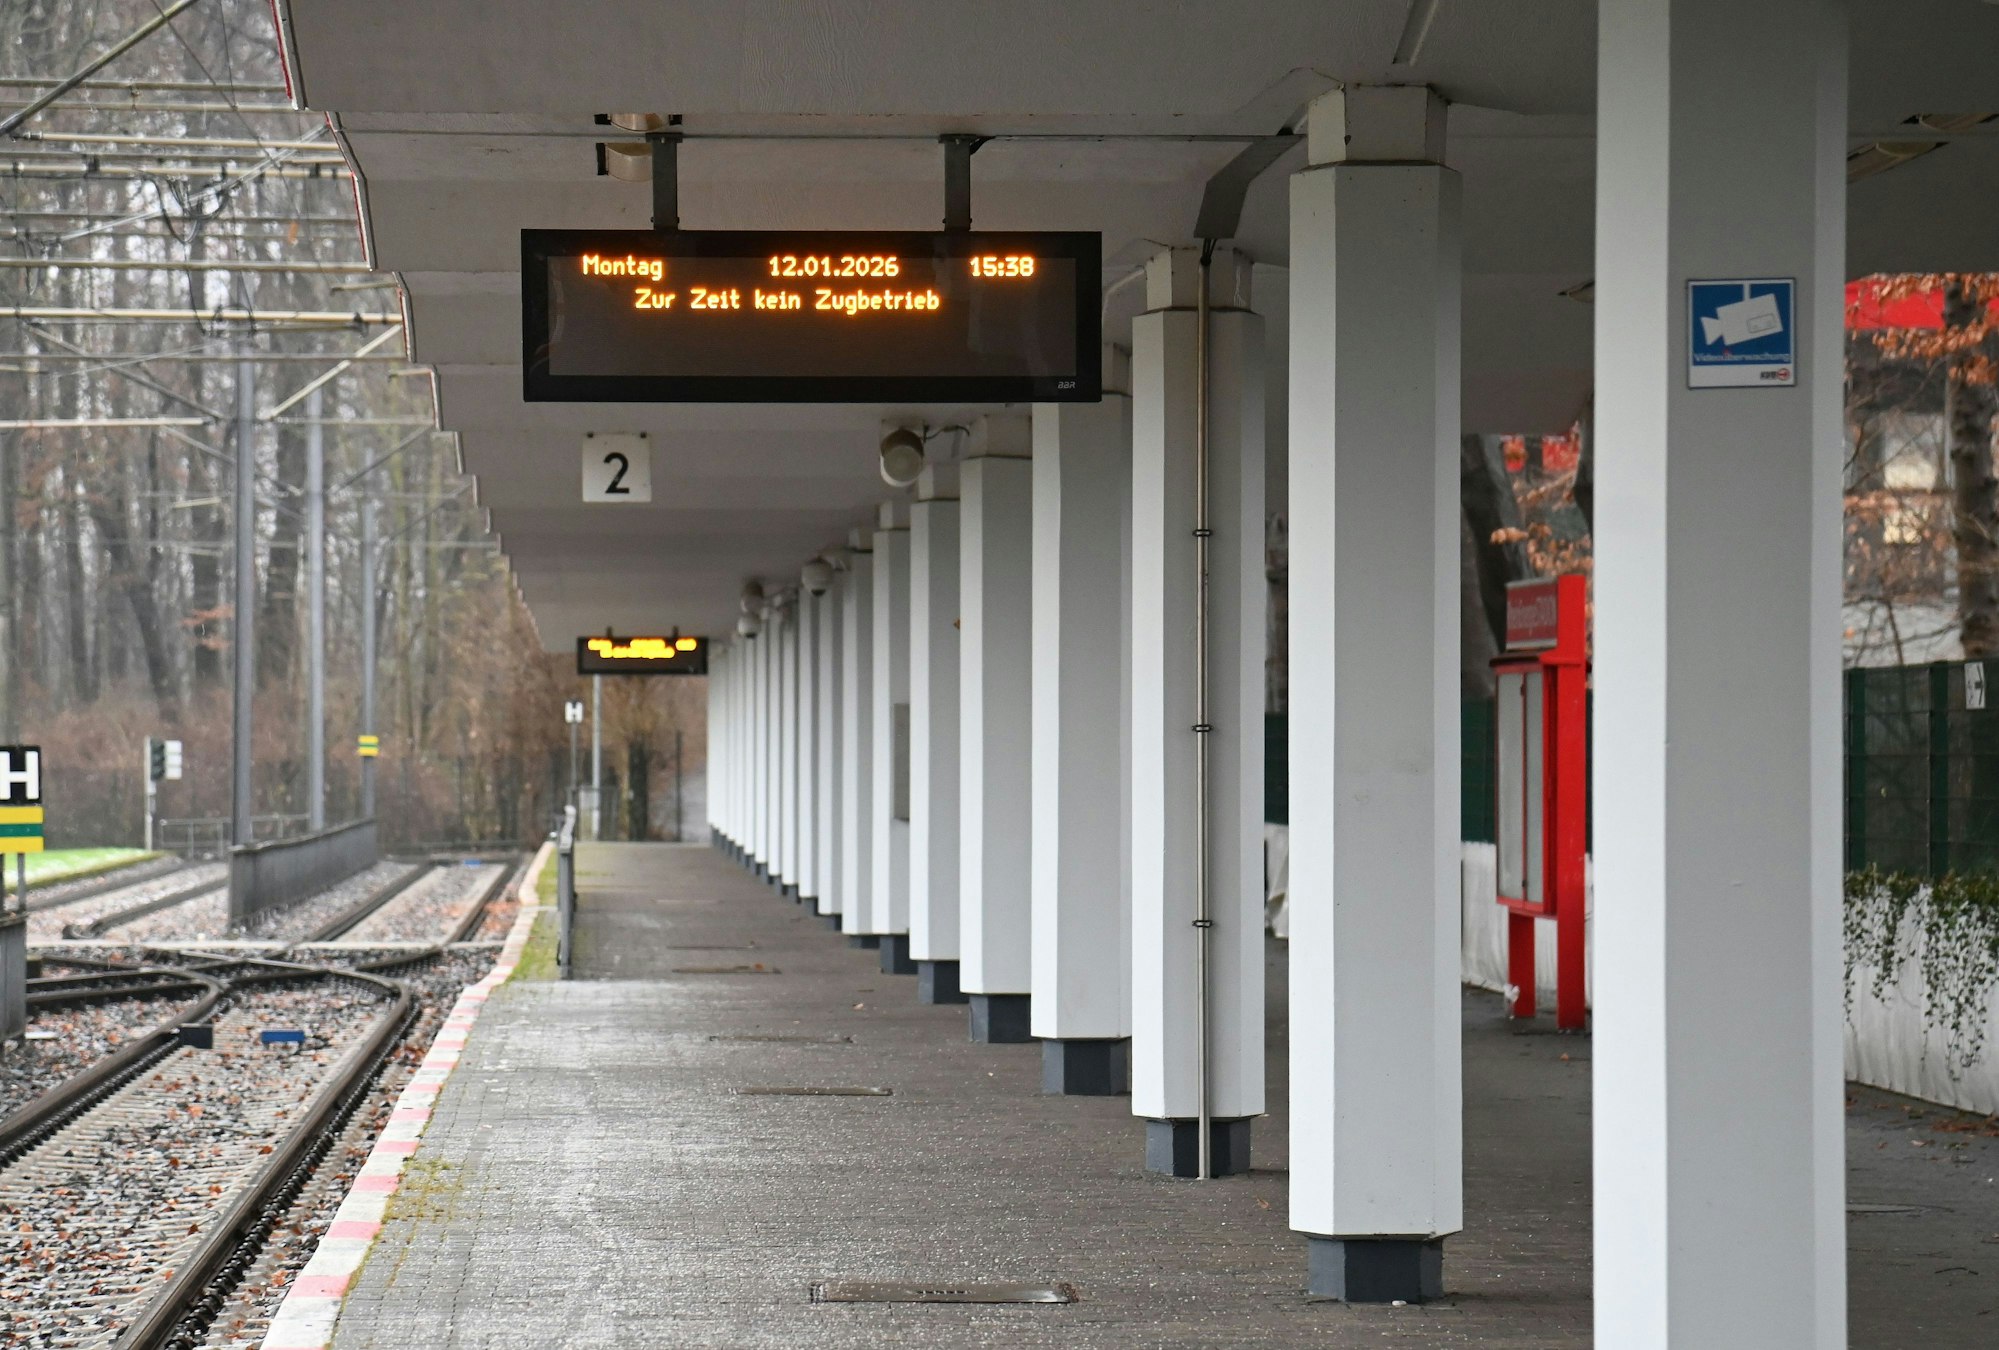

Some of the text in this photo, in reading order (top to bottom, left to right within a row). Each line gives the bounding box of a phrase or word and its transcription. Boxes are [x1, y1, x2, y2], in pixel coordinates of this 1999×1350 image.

[582, 254, 1035, 281] Montag 12.01.2026 15:38
[634, 287, 941, 316] Zur Zeit kein Zugbetrieb
[603, 451, 630, 494] 2
[564, 700, 584, 724] H
[0, 751, 40, 800] H
